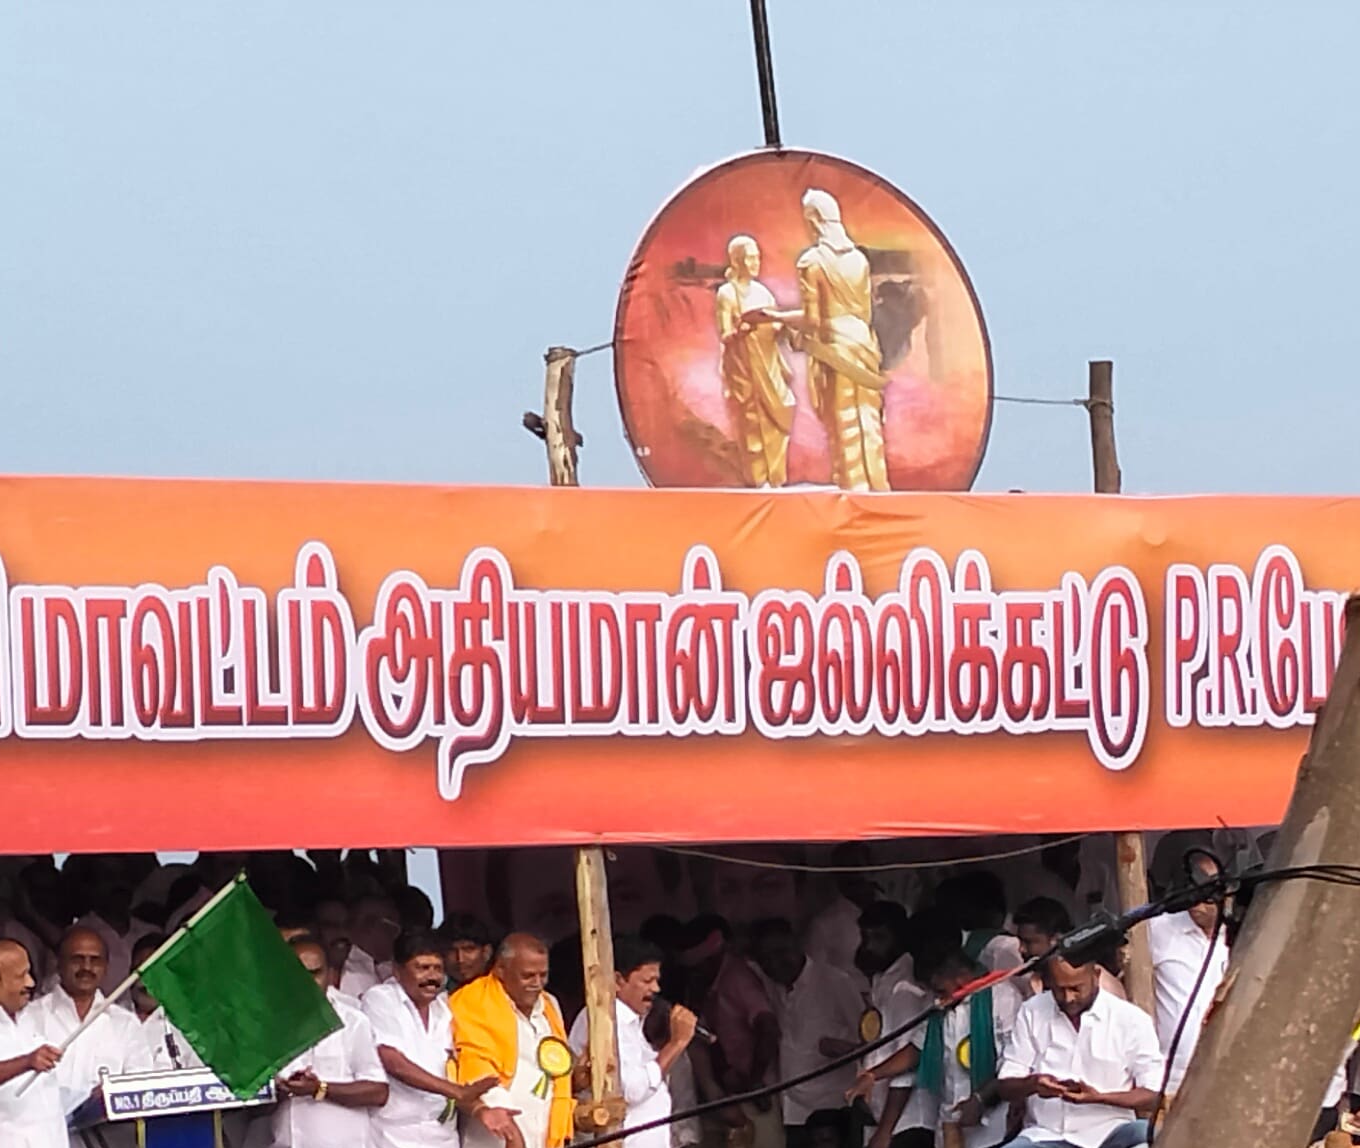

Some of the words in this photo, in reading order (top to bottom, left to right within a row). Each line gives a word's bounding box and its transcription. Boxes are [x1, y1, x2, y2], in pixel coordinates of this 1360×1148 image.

[15, 539, 351, 742] மாவட்டம்
[351, 543, 746, 800] அதியமான்
[751, 547, 1149, 770] ஜல்லிக்கட்டு
